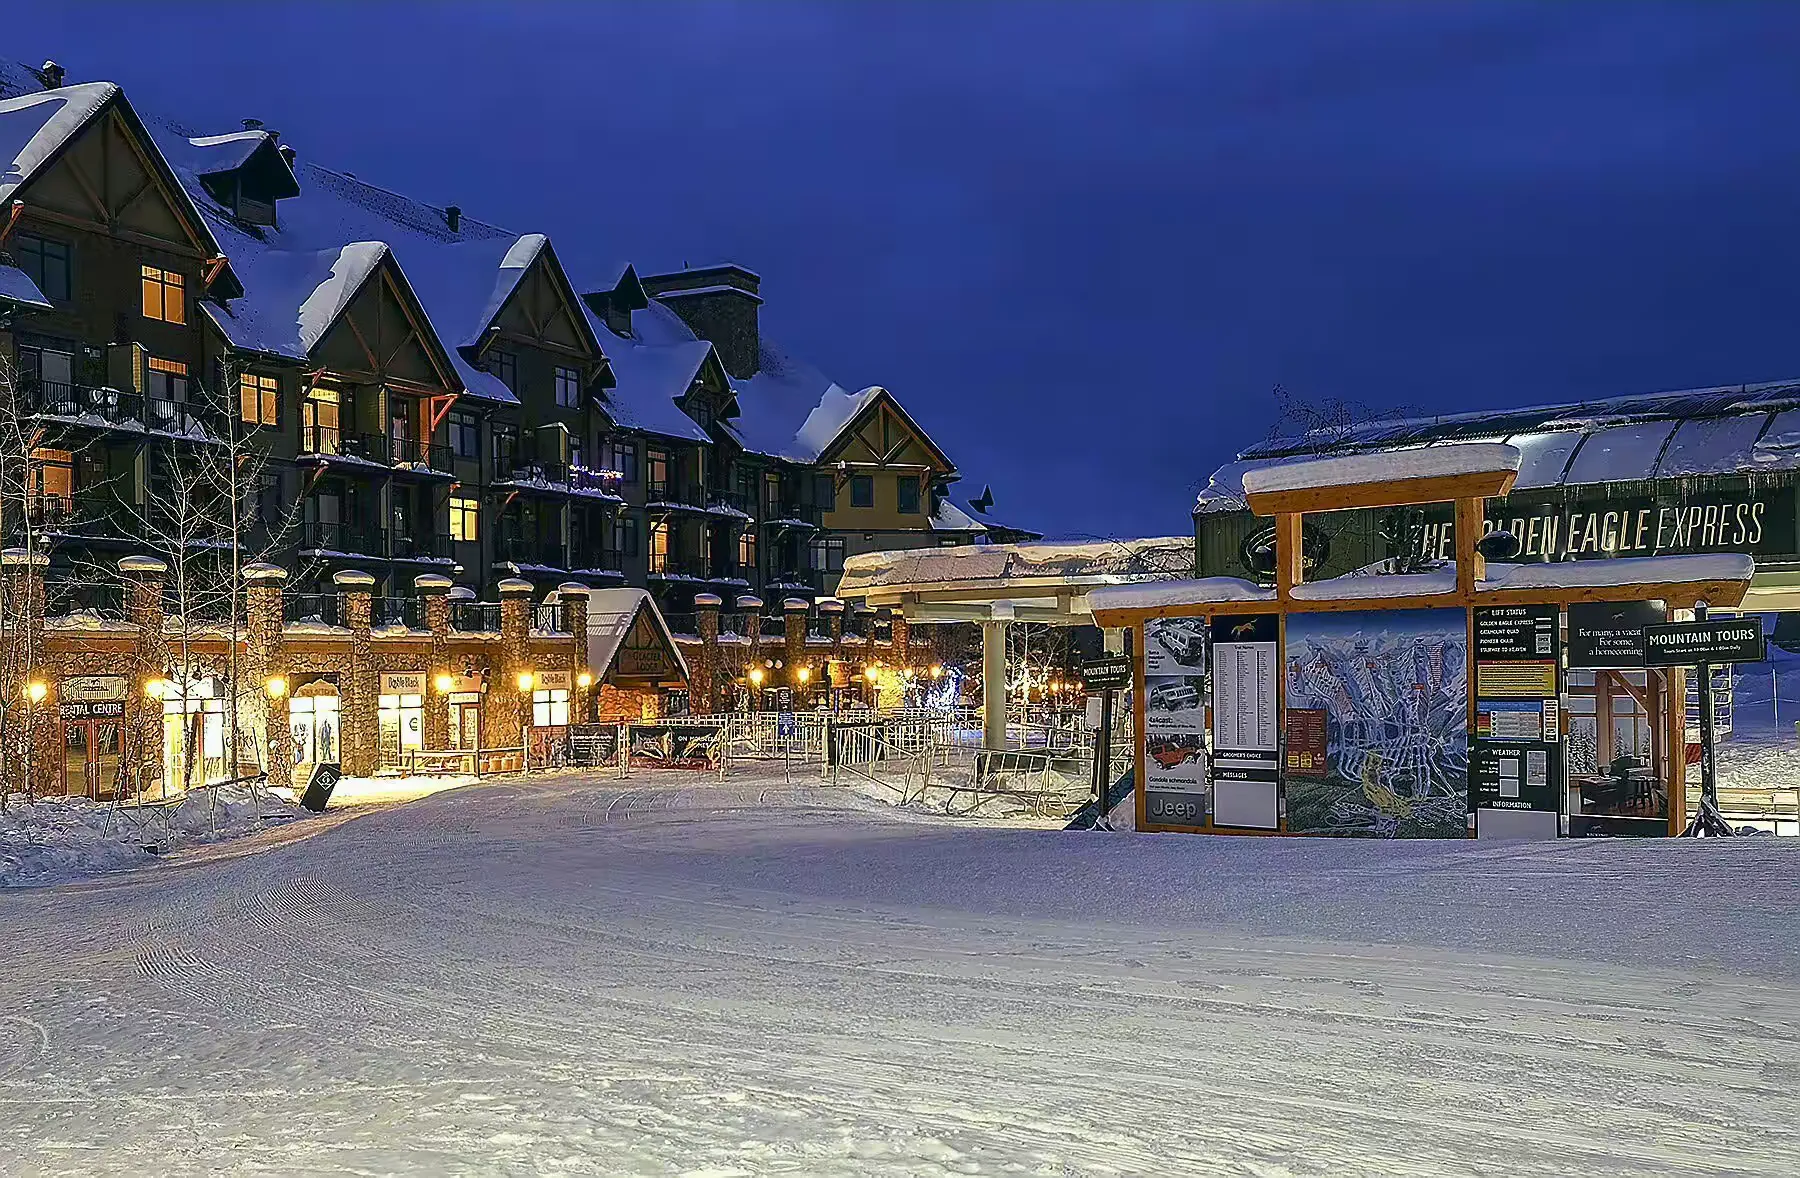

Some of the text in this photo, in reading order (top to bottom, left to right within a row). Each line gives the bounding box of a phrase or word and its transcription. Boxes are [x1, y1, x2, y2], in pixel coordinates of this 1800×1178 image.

[1567, 509, 1650, 553] EAGLE
[1655, 502, 1765, 549] EXPRESS
[1579, 628, 1591, 637] For
[1592, 630, 1614, 638] many,
[1649, 628, 1755, 646] MOUNTAIN TOURS
[1599, 637, 1611, 646] For
[1083, 664, 1127, 677] MOUNTAIN TOURS
[92, 703, 123, 714] CENTRE
[1222, 771, 1248, 779] MESSAGES
[1152, 799, 1197, 820] Jeep
[1492, 801, 1532, 809] INFORMATION
